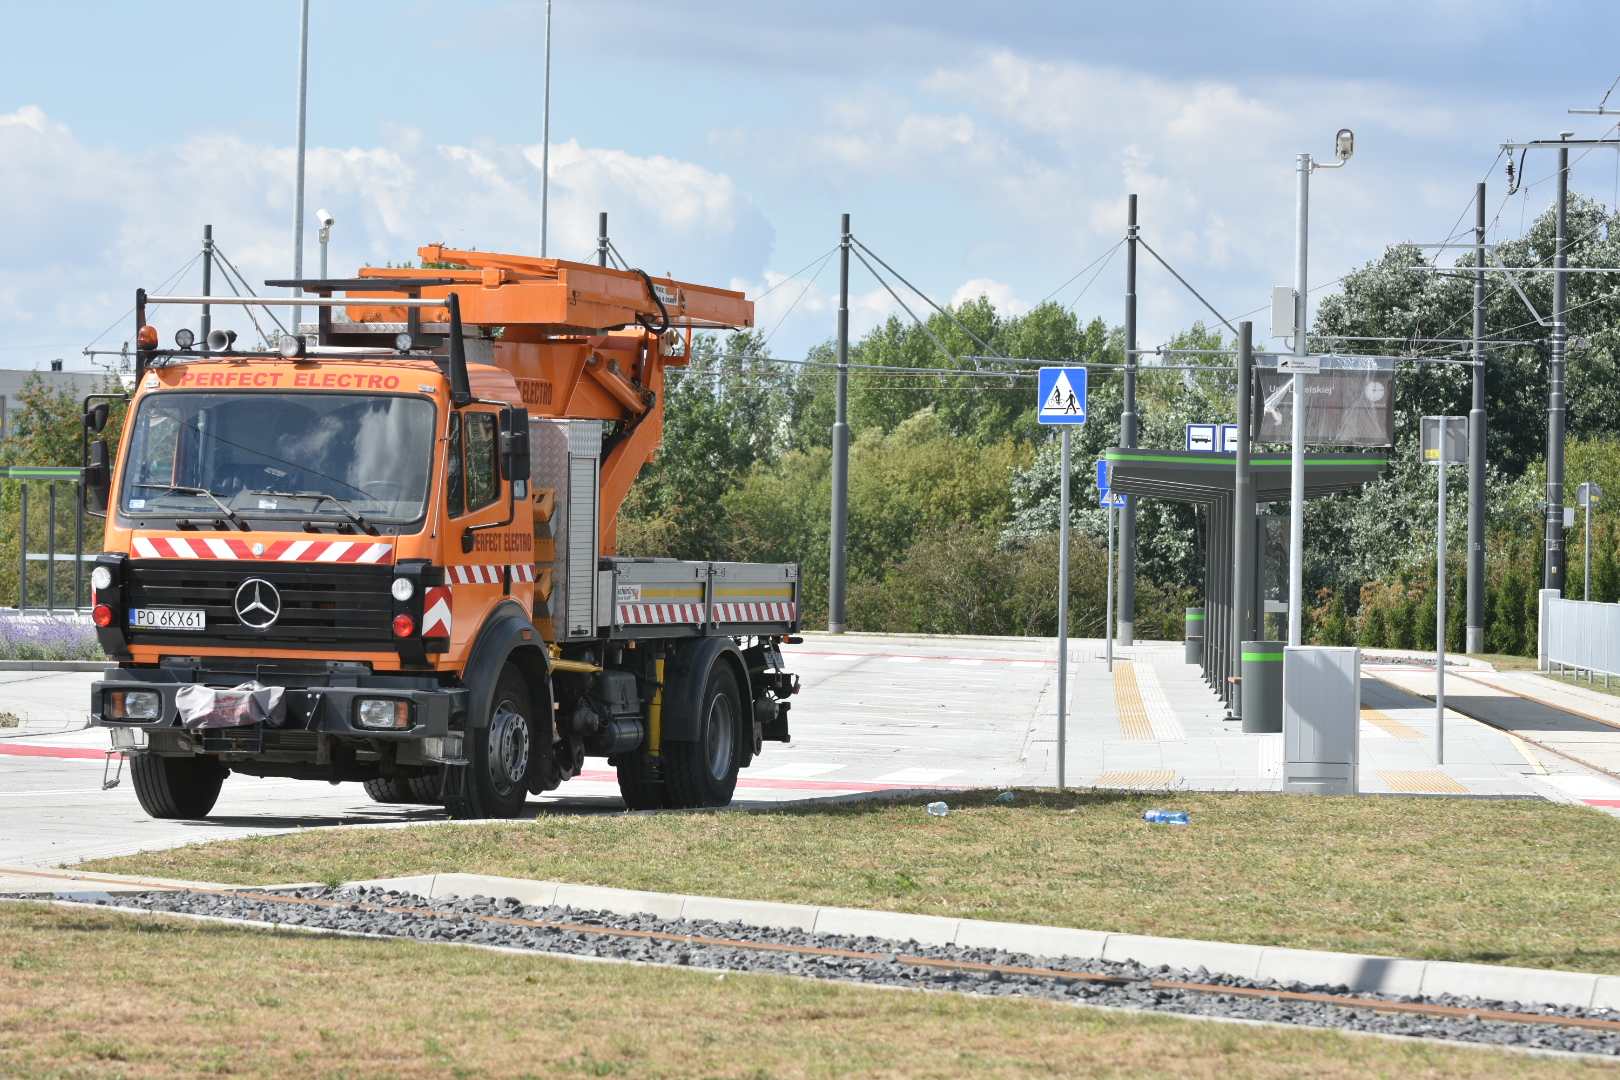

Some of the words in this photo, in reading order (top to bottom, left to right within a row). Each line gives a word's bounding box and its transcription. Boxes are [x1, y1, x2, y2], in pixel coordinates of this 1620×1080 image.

[181, 372, 284, 387] PERFECT
[293, 373, 400, 390] ELECTRO
[522, 381, 553, 406] ELECTRO
[1288, 385, 1332, 396] Lelskiej
[473, 532, 502, 552] ERFECT
[504, 532, 532, 552] ELECTRO
[137, 610, 155, 625] PO
[160, 611, 201, 626] 6KX61
